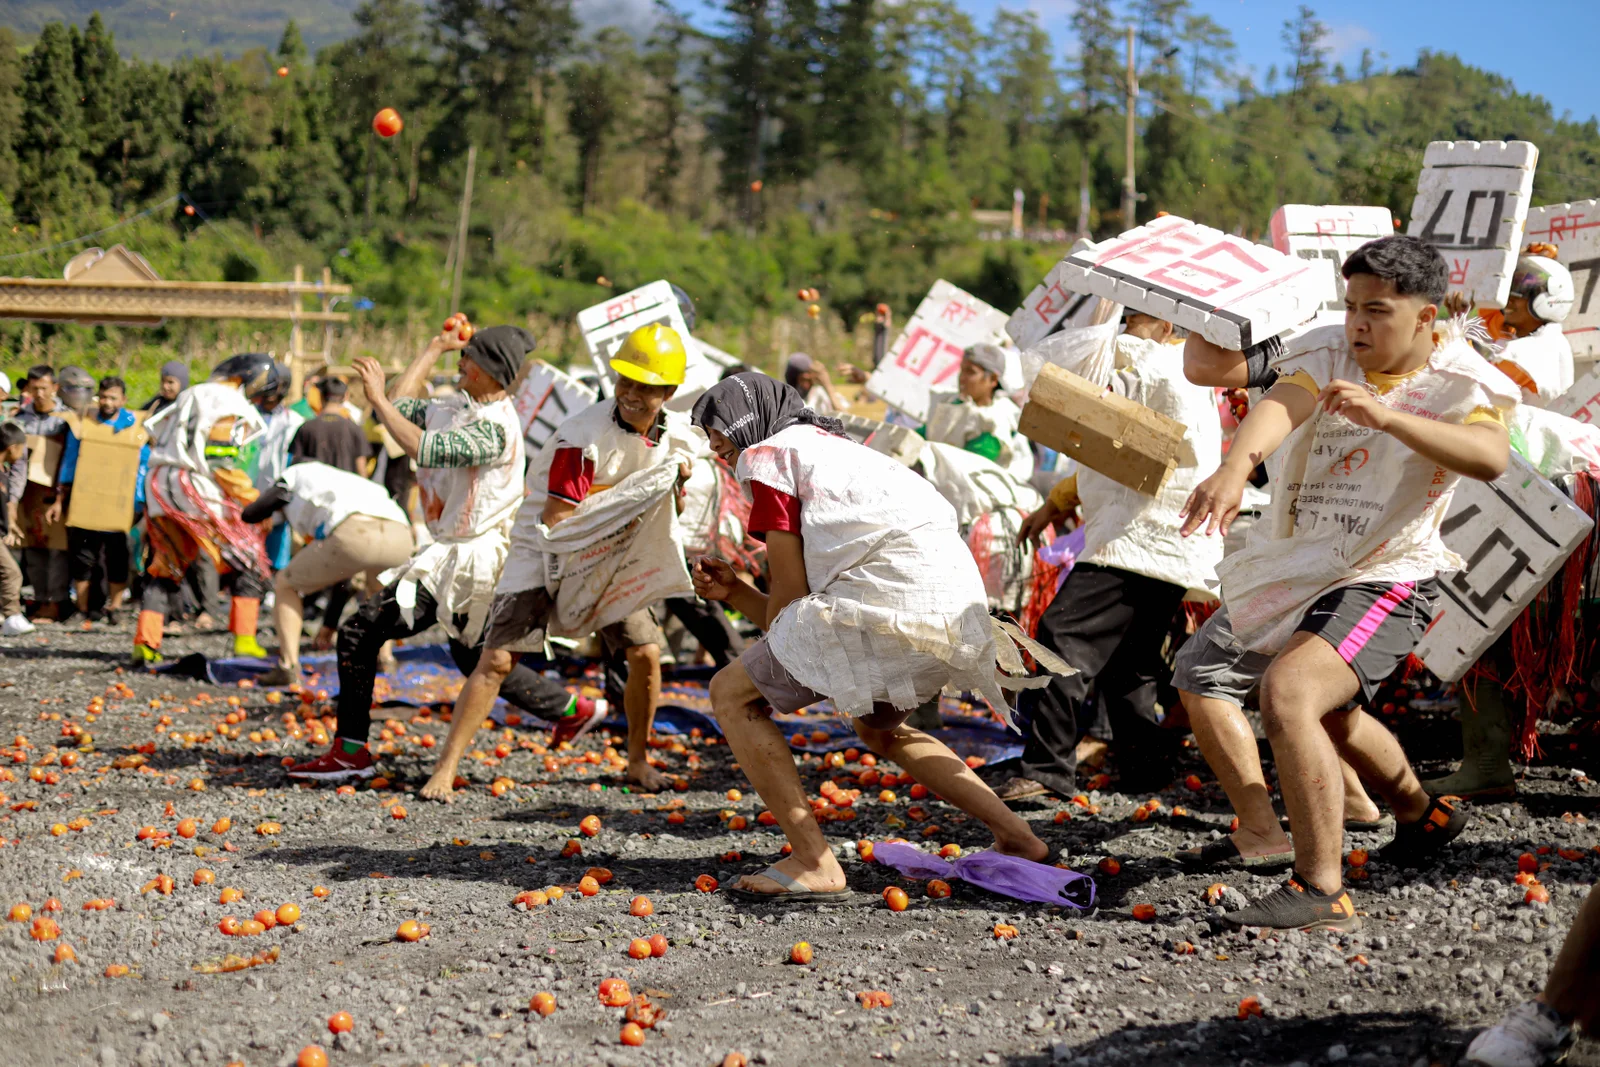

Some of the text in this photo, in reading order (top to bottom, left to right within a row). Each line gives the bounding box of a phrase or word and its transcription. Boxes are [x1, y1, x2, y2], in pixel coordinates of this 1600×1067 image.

[1314, 218, 1355, 246] RT
[1420, 189, 1506, 249] 07
[1549, 213, 1585, 242] RT
[1448, 258, 1471, 285] R
[1568, 257, 1600, 315] 7
[606, 294, 641, 327] RT
[1034, 280, 1071, 325] RT
[895, 326, 965, 385] 07
[1415, 406, 1443, 421] RANG
[1309, 444, 1346, 458] JAP
[1335, 483, 1362, 492] UMUR
[1325, 496, 1359, 508] LENGKAP
[1358, 499, 1384, 512] PAKAN
